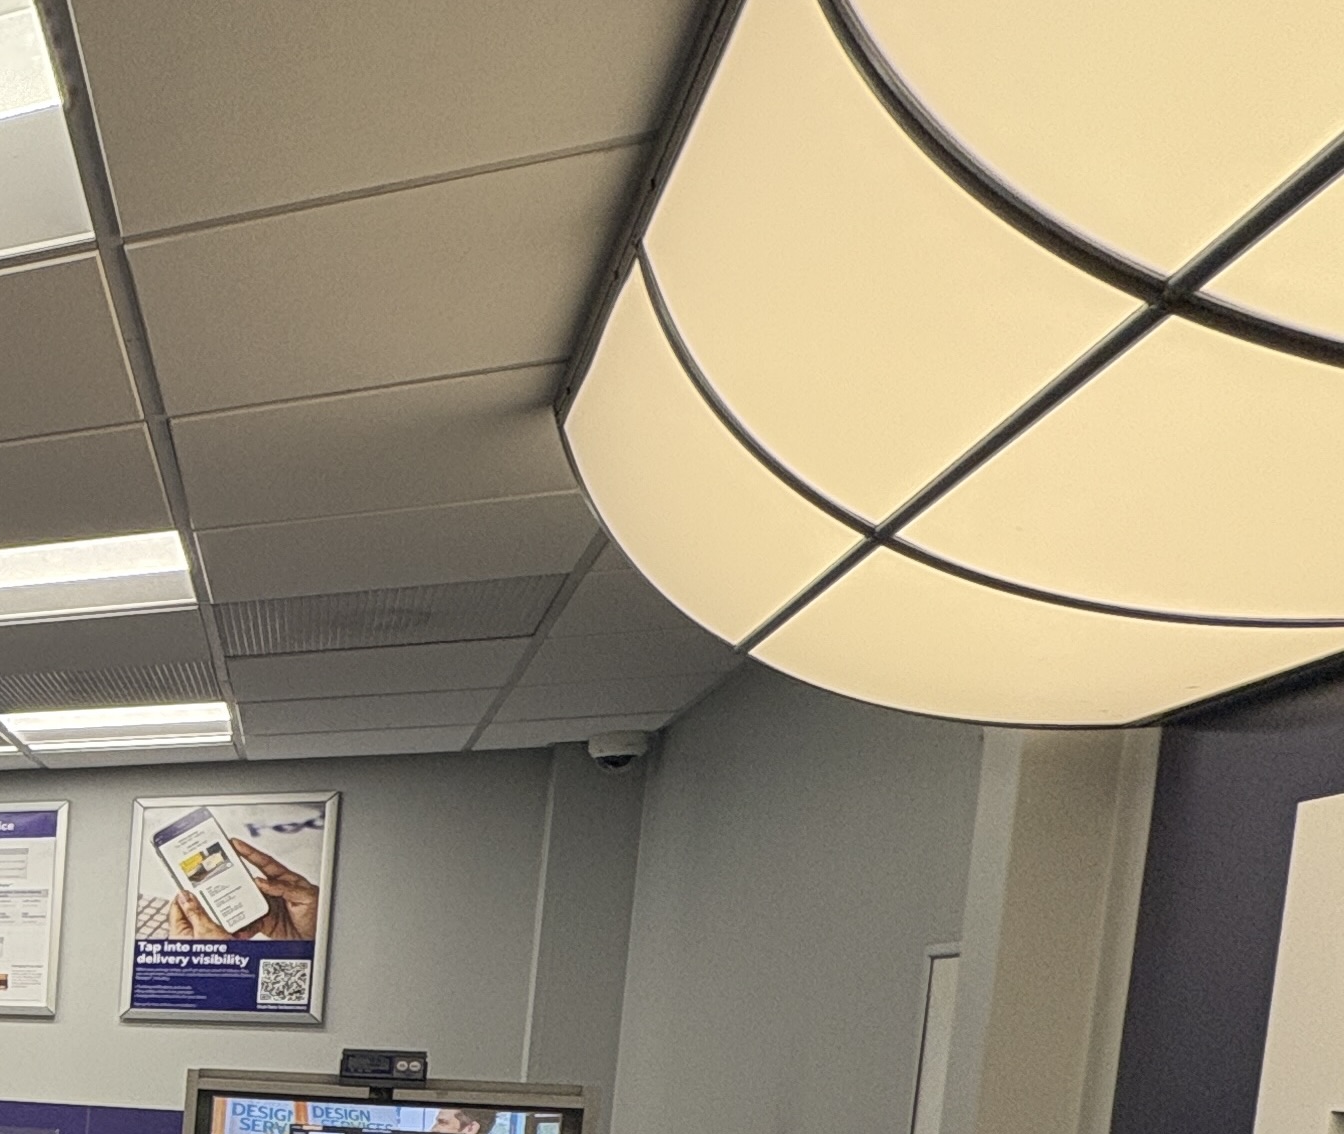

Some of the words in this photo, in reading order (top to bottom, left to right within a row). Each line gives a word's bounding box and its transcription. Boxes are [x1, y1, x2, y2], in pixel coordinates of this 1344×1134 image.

[138, 942, 161, 954] Tap
[164, 942, 190, 952] into
[192, 943, 227, 953] more
[137, 954, 189, 966] delivery
[192, 954, 249, 967] visibility
[313, 1105, 370, 1122] DESIGN
